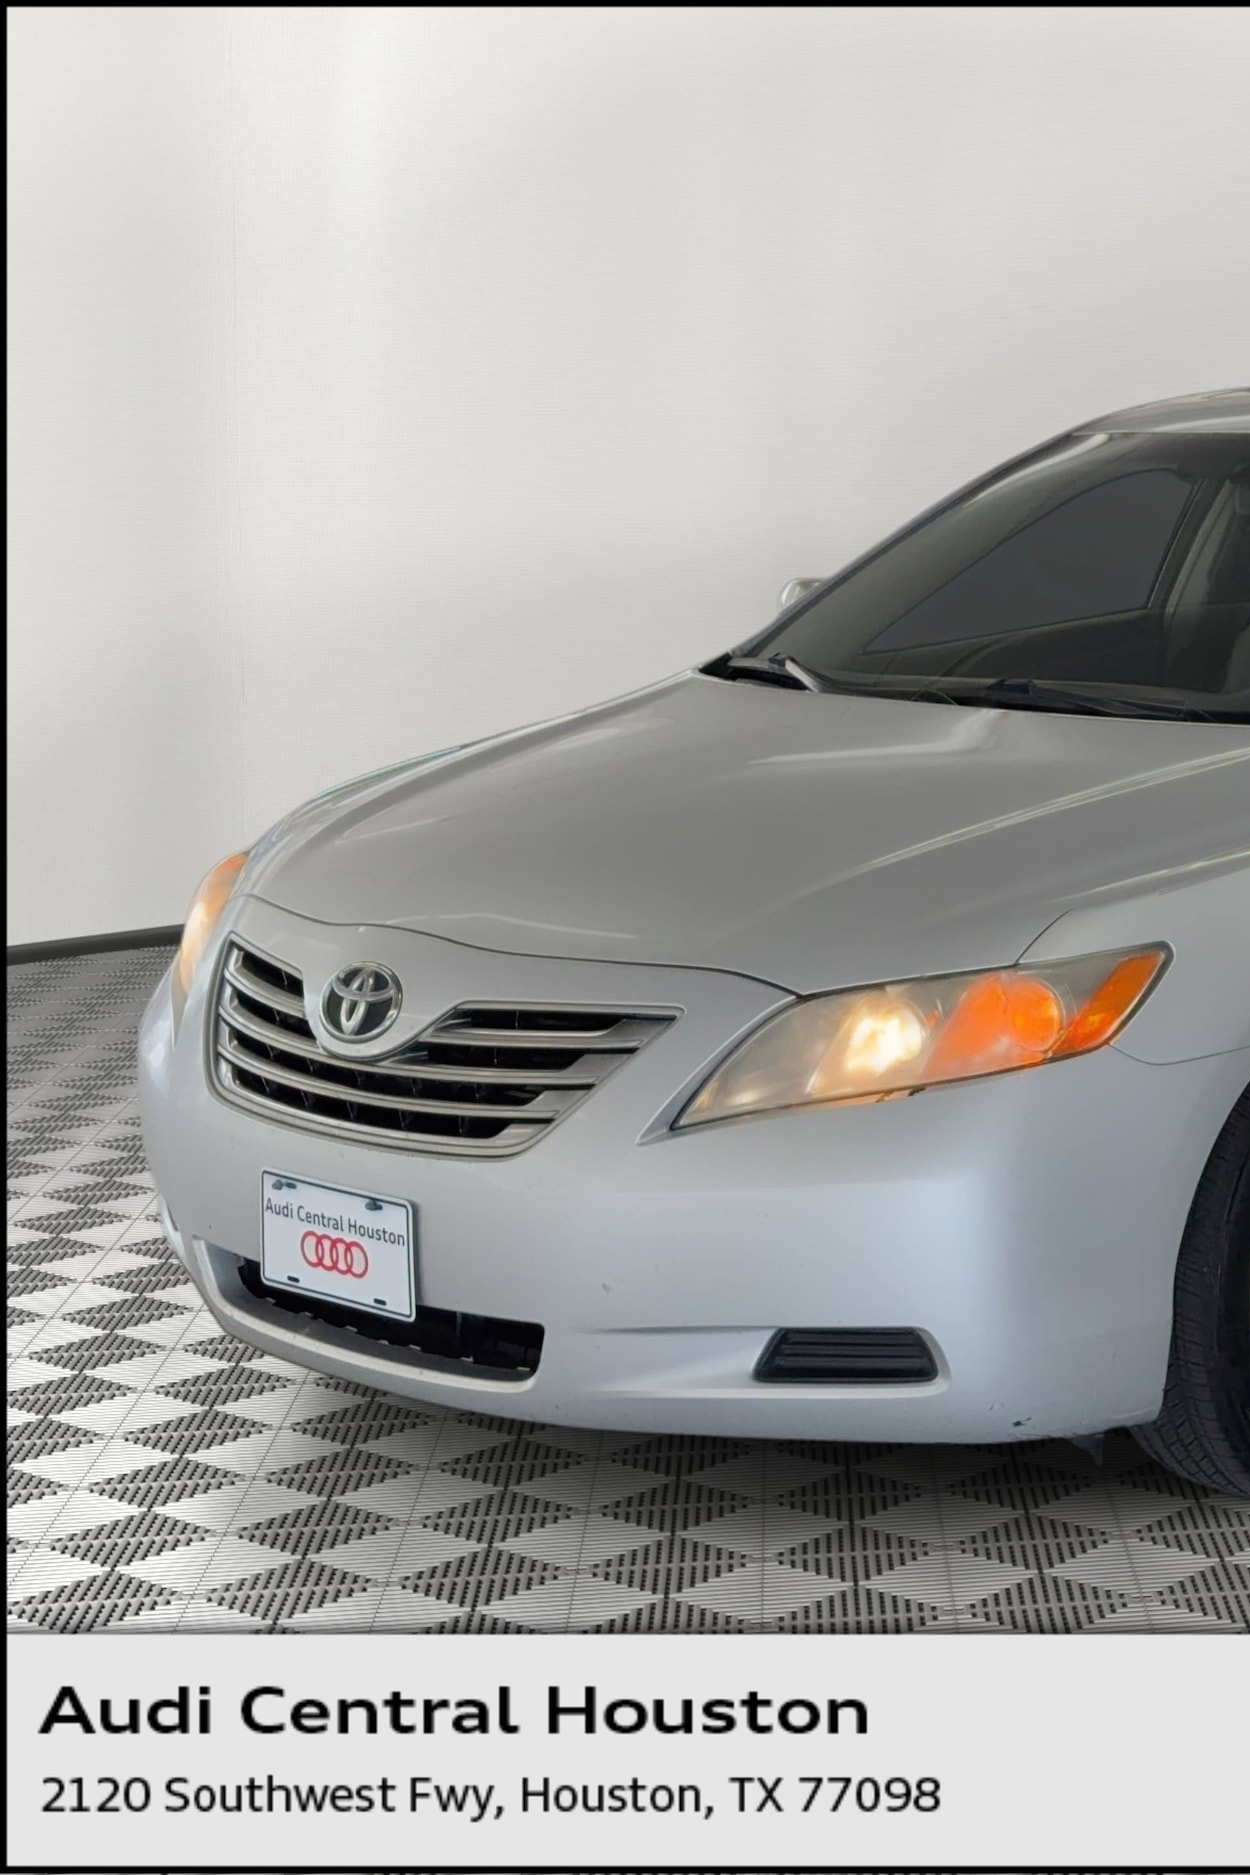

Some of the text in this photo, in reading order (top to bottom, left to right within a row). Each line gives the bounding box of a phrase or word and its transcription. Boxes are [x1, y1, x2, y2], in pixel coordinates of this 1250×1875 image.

[265, 1197, 405, 1247] Audi Central Houston
